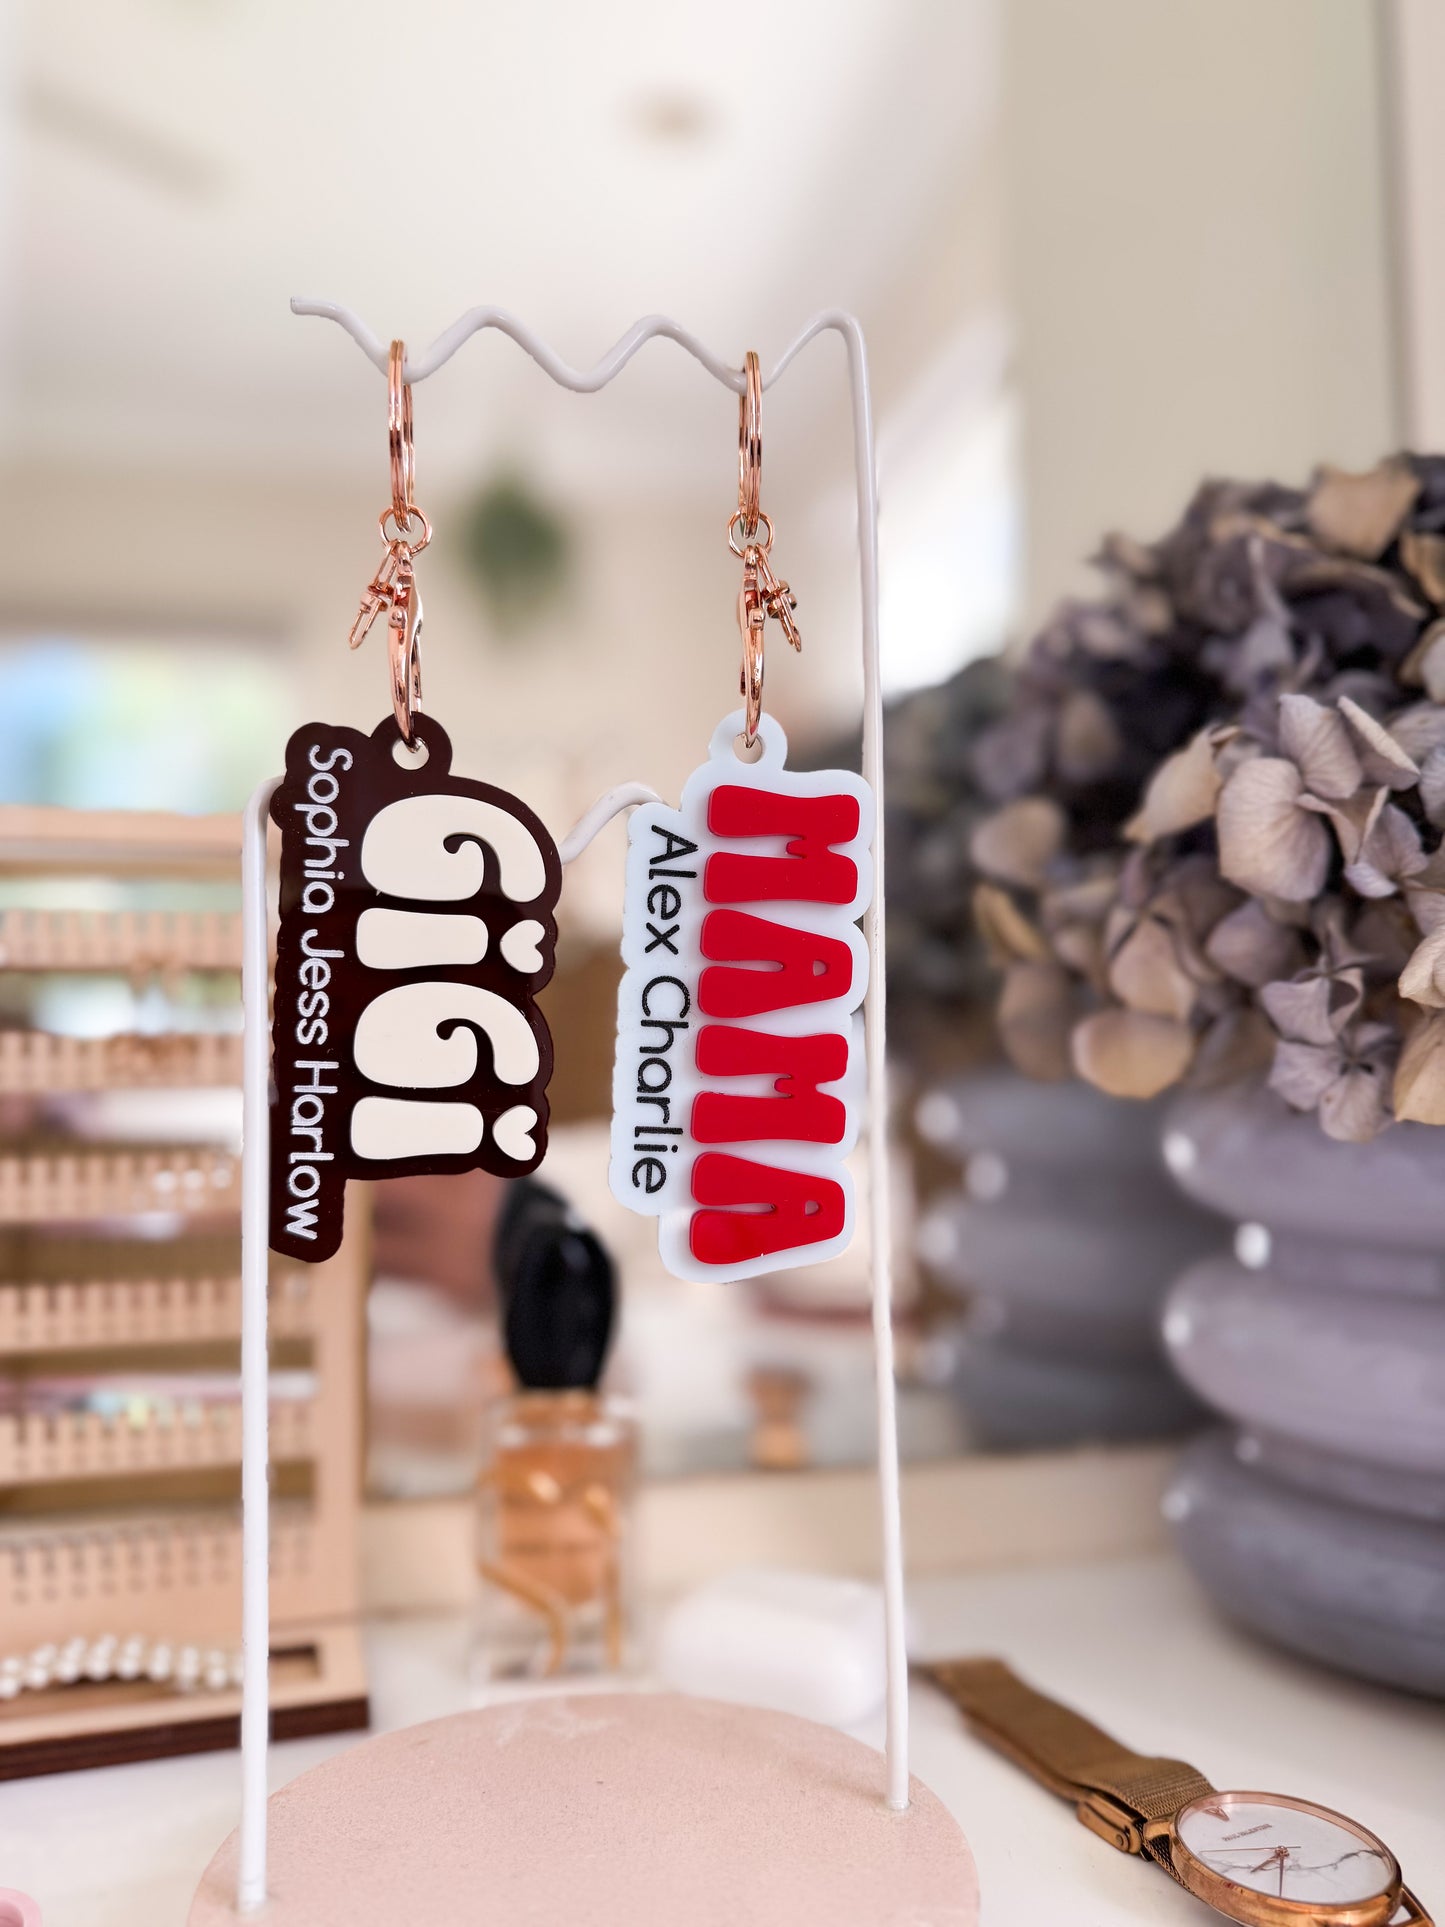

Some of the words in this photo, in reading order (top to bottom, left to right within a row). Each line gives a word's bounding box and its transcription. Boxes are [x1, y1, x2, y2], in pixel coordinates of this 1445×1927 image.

[294, 744, 353, 914] Sophia
[644, 824, 698, 955] Alex
[294, 929, 344, 1045] Jess
[689, 784, 860, 1265] MAMA
[284, 1060, 339, 1241] Harlow
[631, 976, 690, 1194] Charlie
